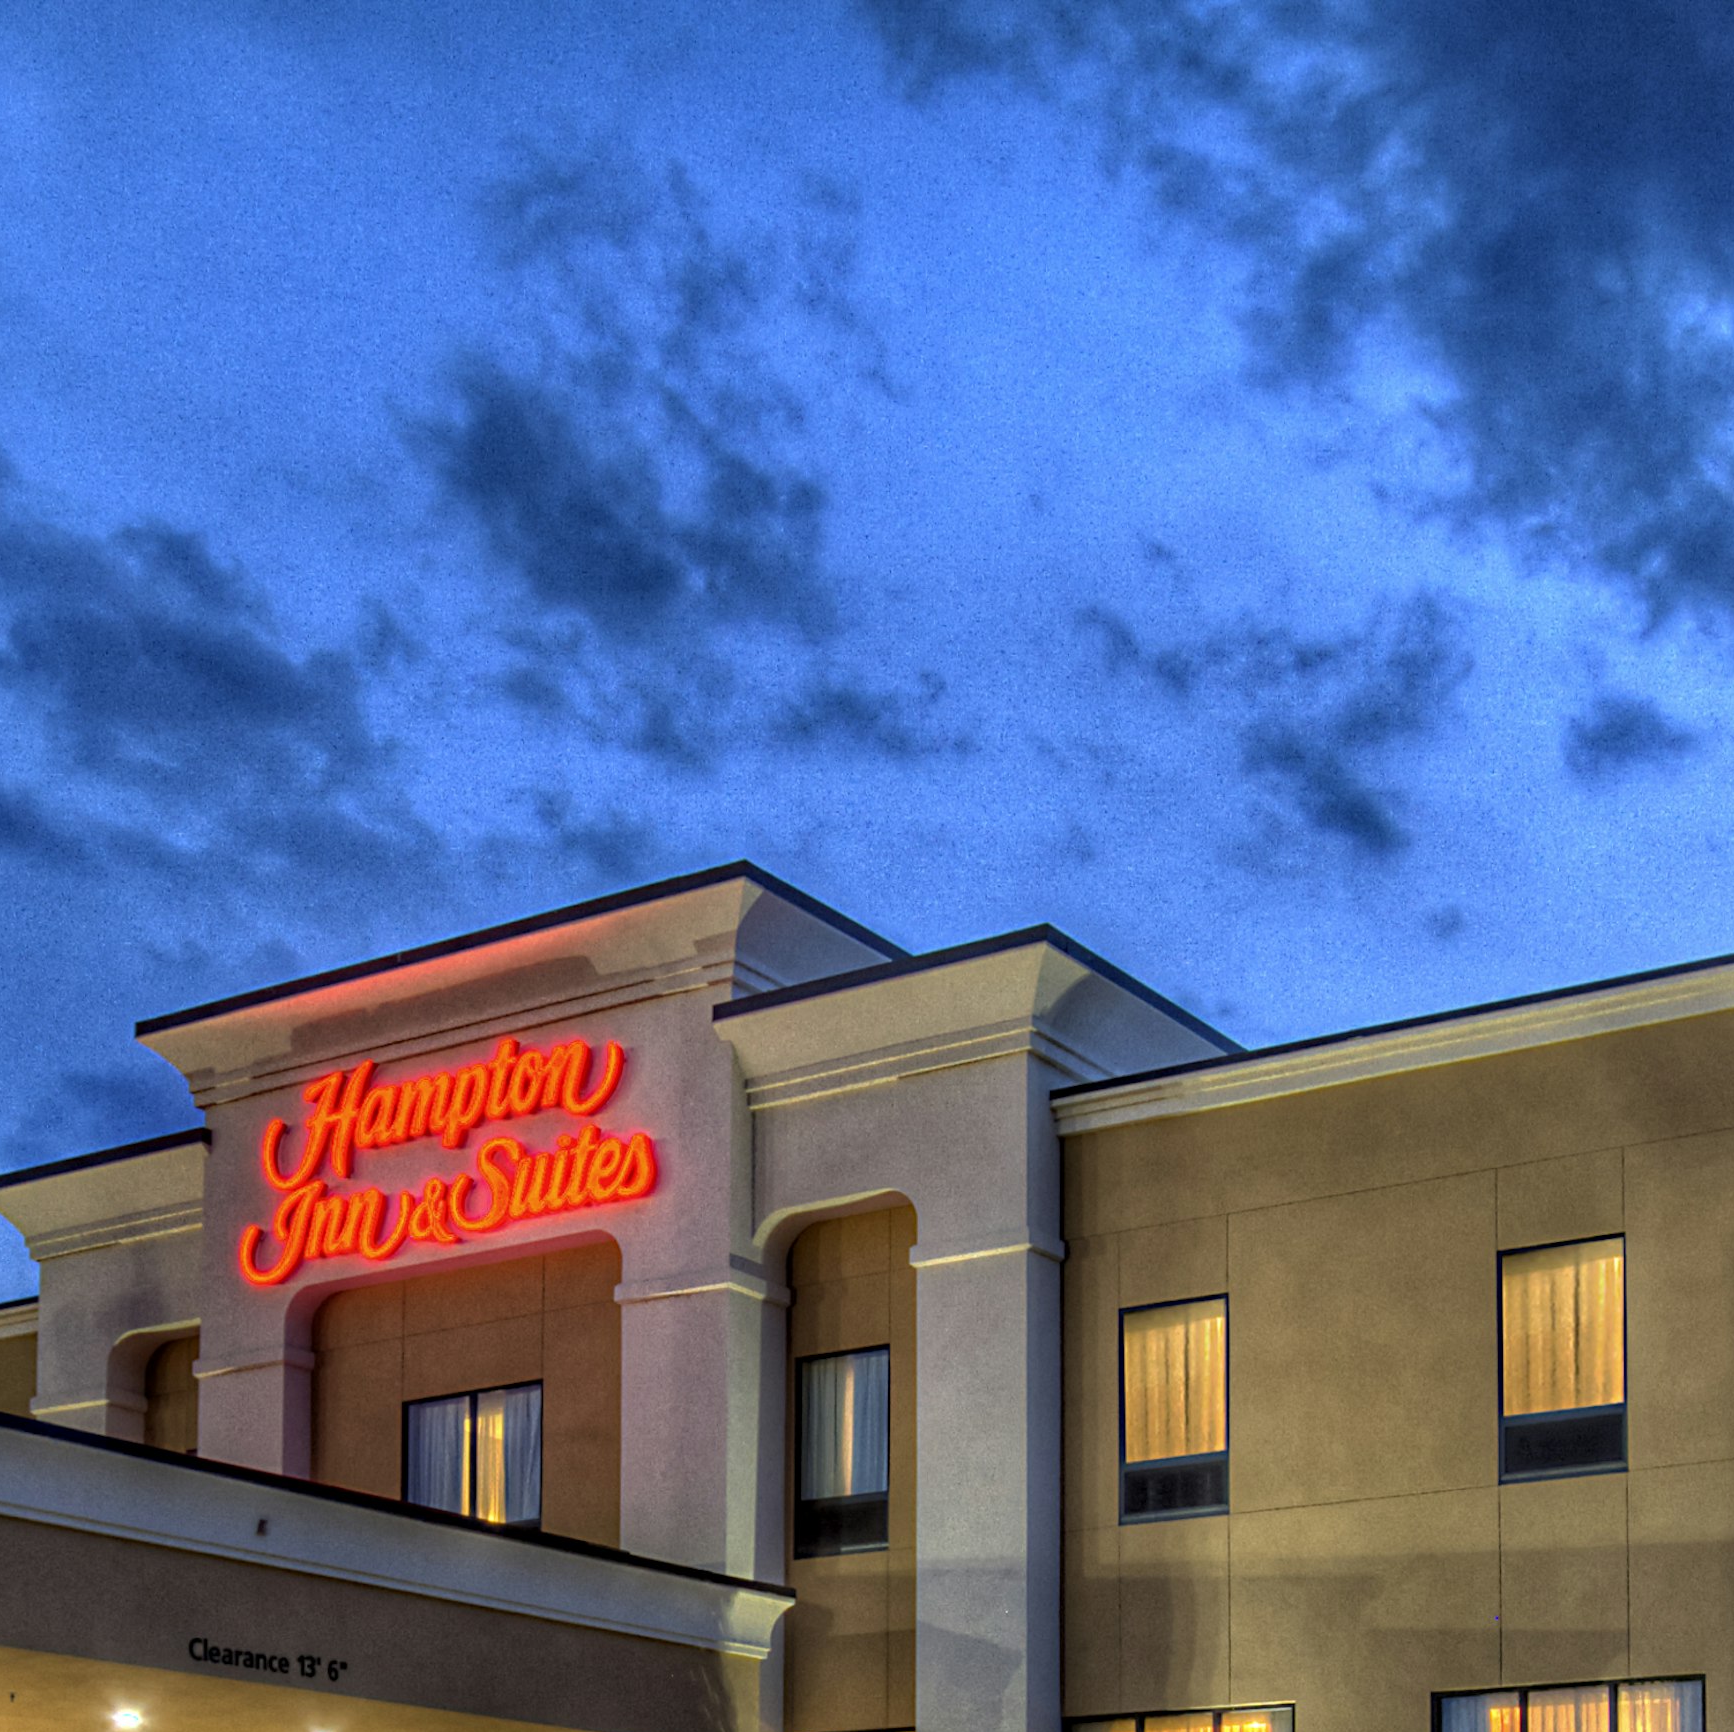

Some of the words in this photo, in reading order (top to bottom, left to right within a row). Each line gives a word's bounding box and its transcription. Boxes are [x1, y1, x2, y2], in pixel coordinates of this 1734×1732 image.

[263, 1036, 626, 1191] Hampton
[239, 1178, 413, 1285] Inn
[408, 1177, 461, 1243] &
[448, 1124, 658, 1232] Suites
[188, 1637, 290, 1673] Clearance
[296, 1655, 321, 1678] 13'
